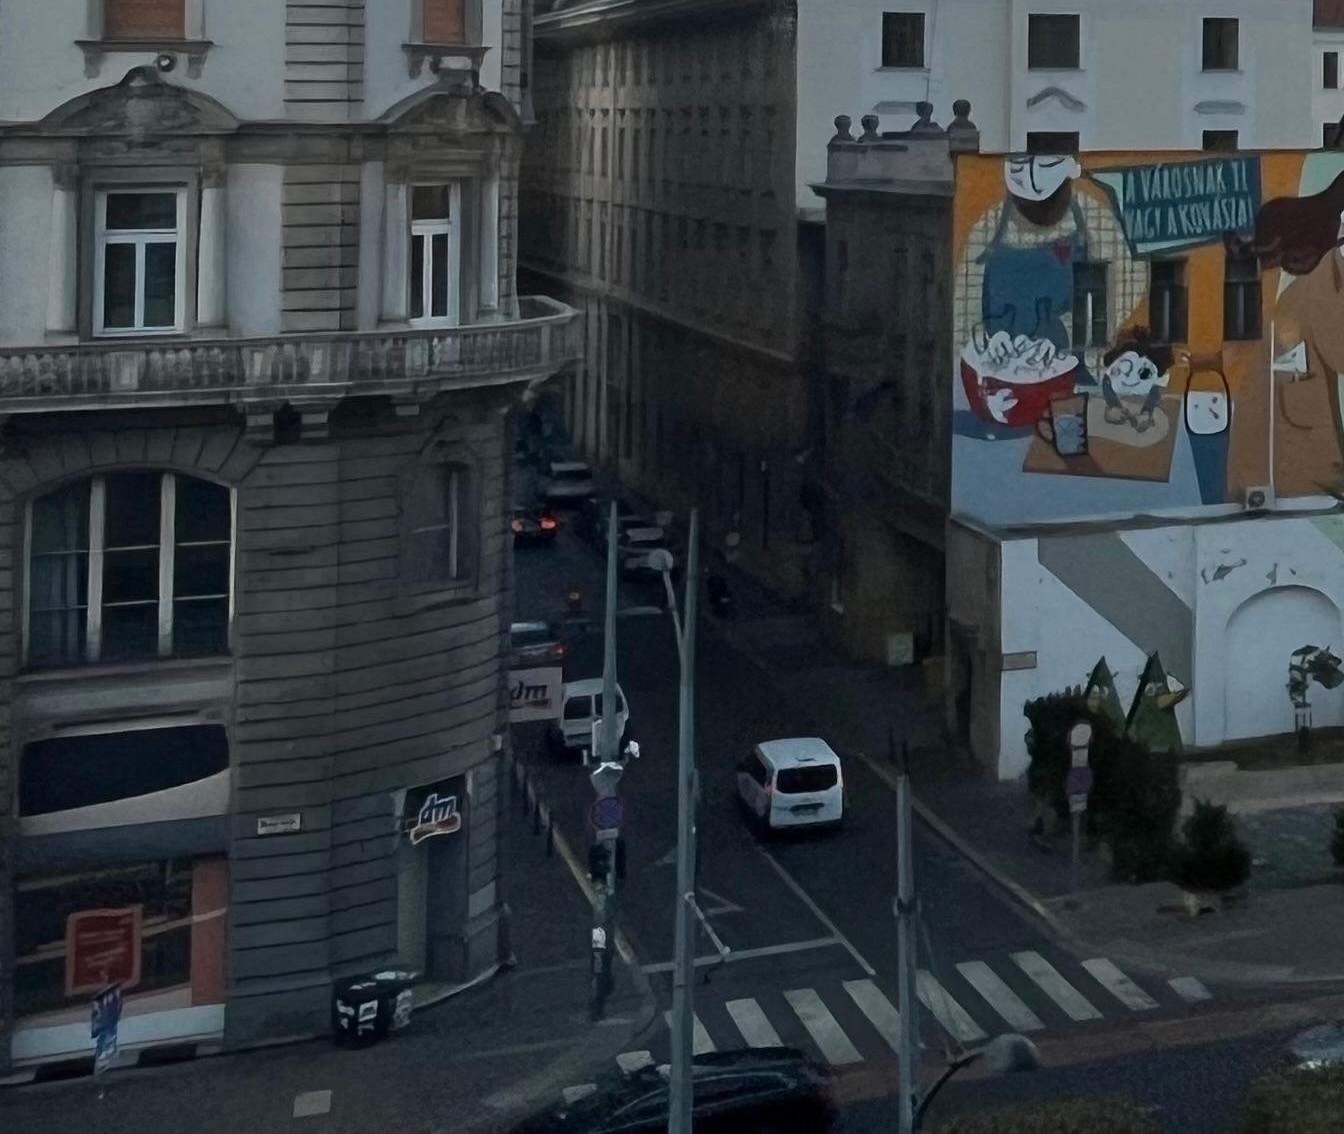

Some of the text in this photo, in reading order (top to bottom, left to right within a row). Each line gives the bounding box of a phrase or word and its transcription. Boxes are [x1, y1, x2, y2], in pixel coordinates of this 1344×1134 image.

[1126, 170, 1135, 203] A
[1168, 204, 1178, 237] A
[511, 680, 548, 701] dm
